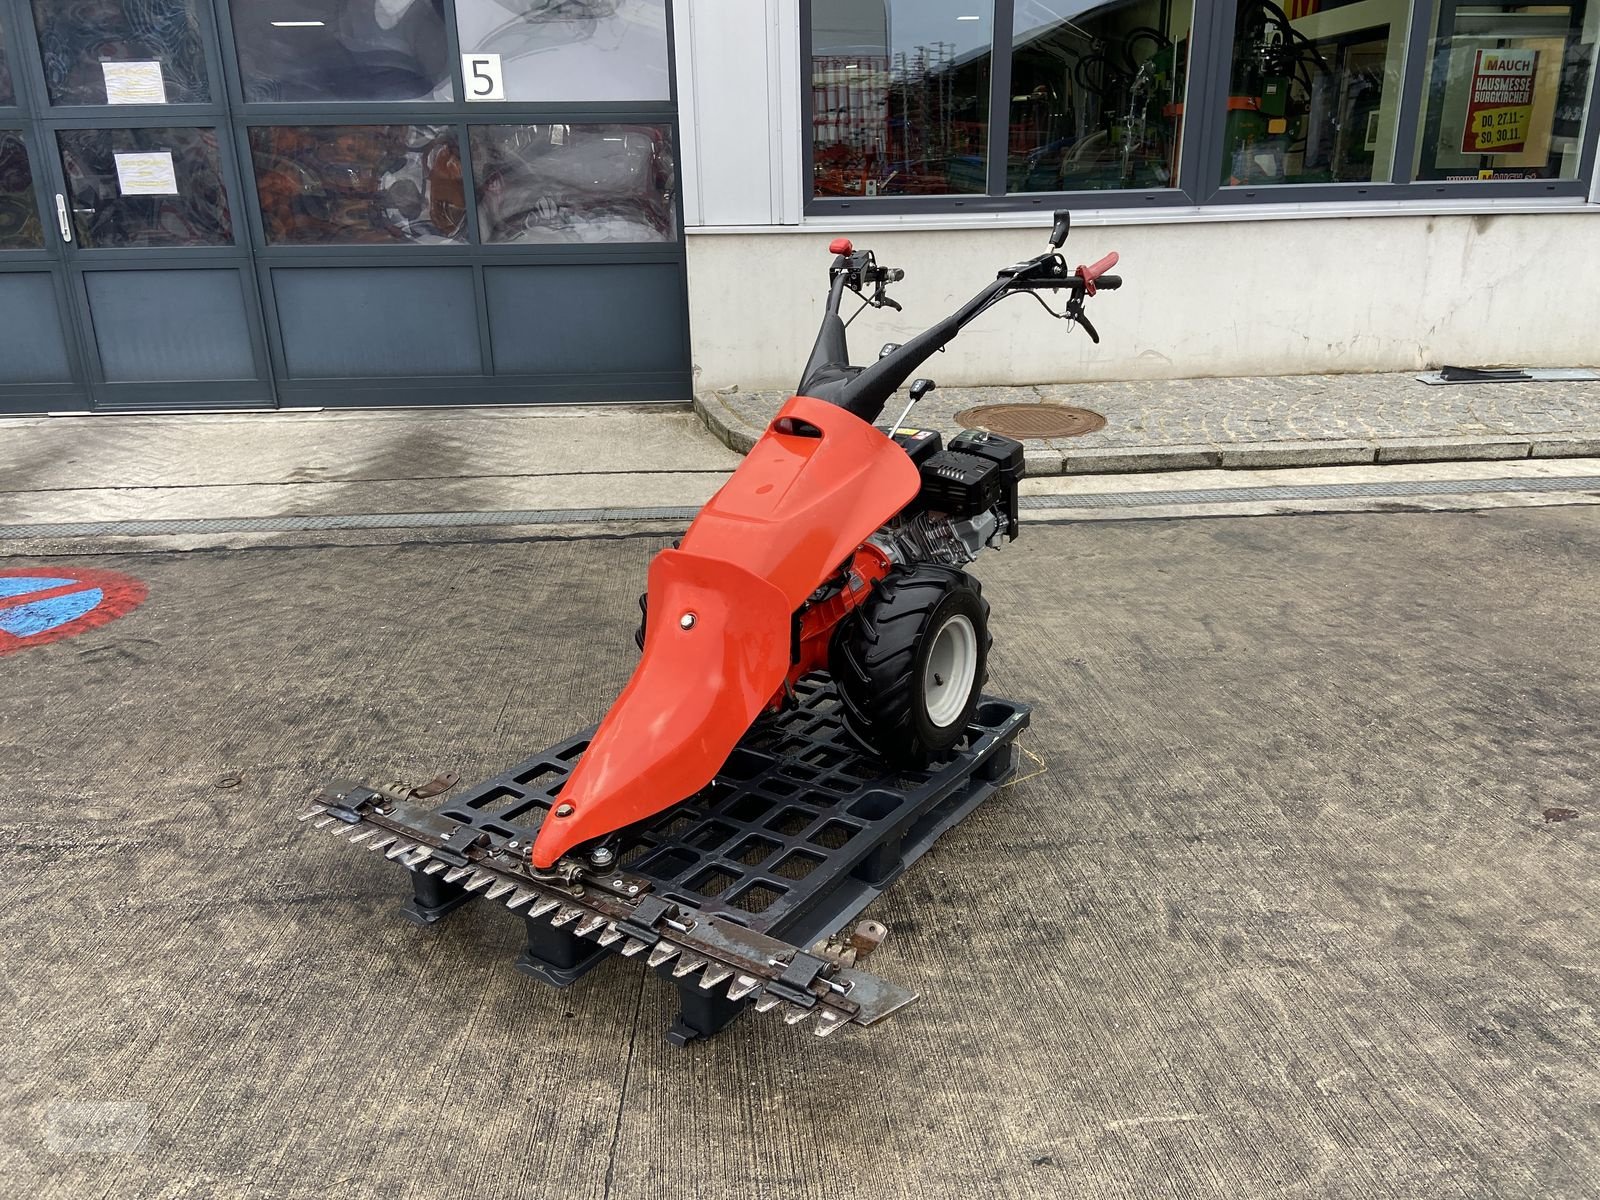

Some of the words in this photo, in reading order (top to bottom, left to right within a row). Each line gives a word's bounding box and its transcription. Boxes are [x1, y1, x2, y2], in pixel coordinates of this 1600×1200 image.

[1487, 60, 1530, 71] MAUCH
[472, 60, 494, 96] 5
[1475, 78, 1531, 91] HAUSMESSE
[1474, 91, 1528, 103] BURGKIRCHEN
[1481, 115, 1494, 128] DO,
[1481, 132, 1493, 144] SO,
[1496, 129, 1521, 142] 30.11.
